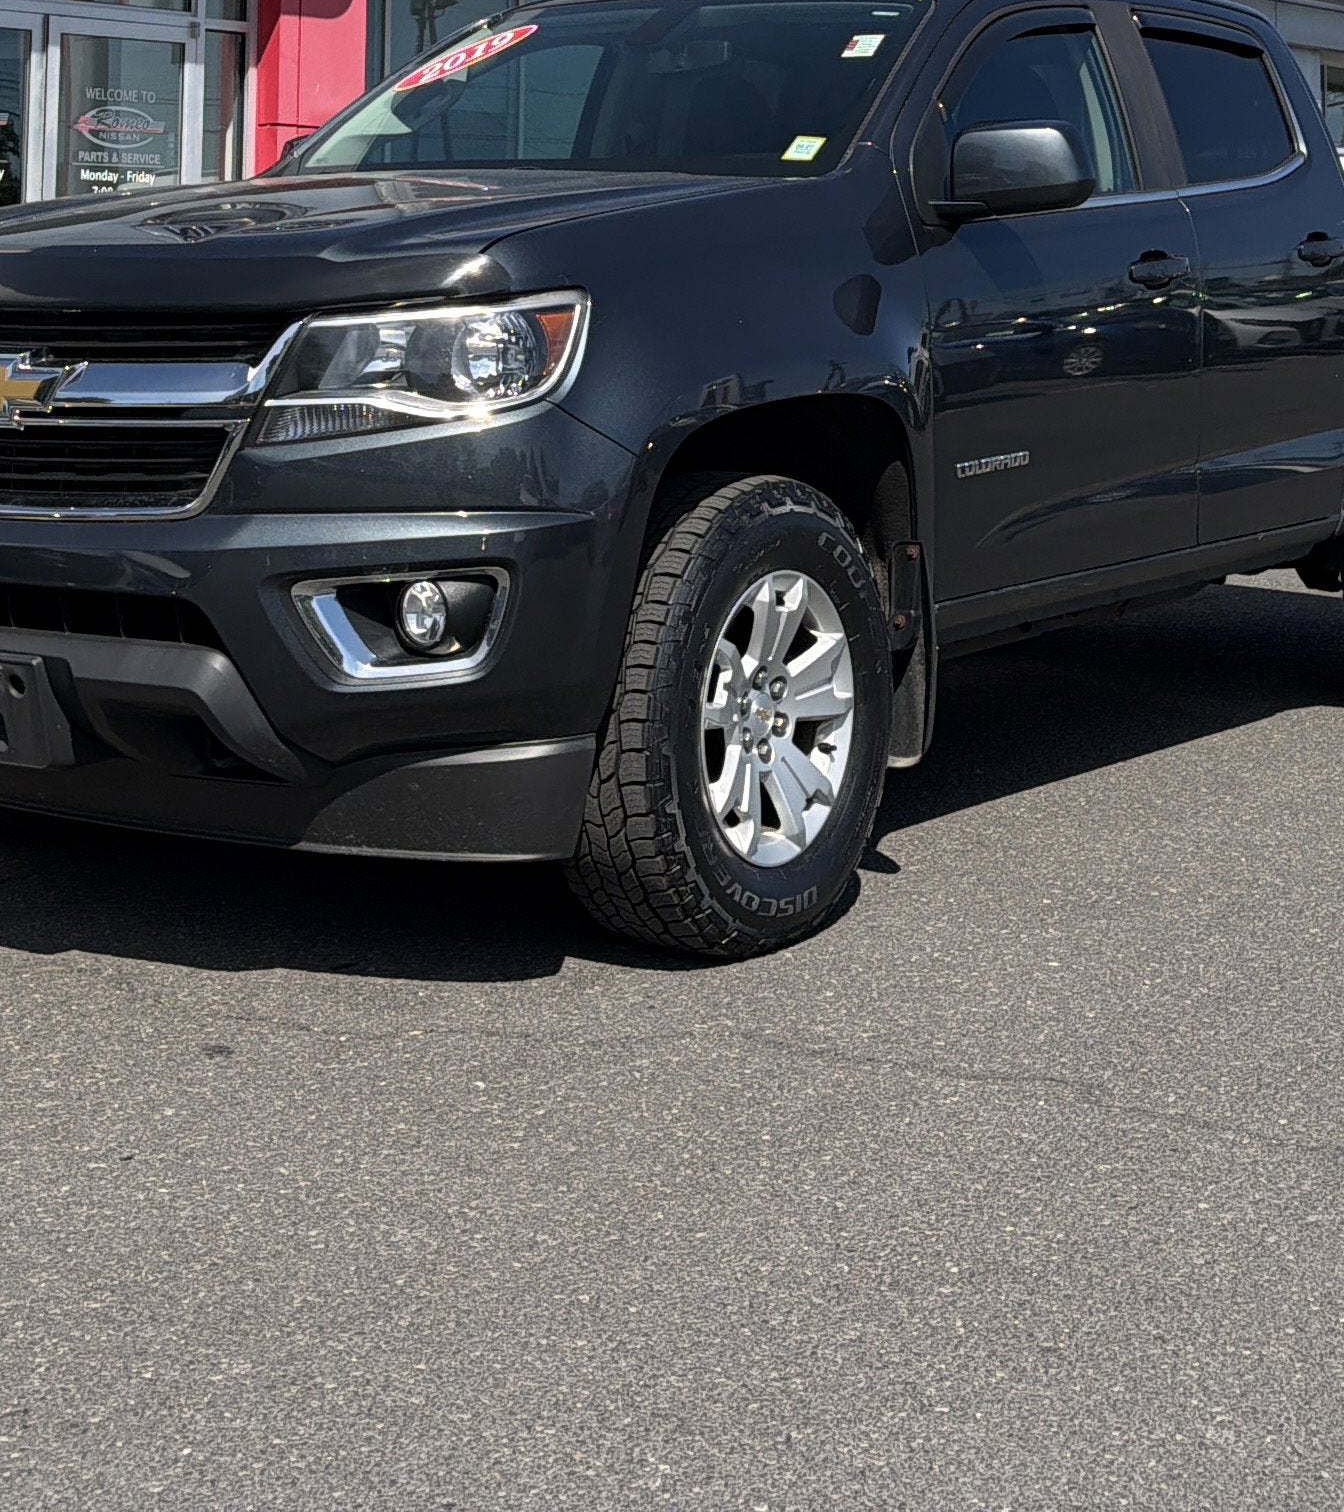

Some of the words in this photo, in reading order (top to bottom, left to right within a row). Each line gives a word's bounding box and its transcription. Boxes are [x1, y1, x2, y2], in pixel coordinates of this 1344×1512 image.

[420, 31, 515, 84] 2019
[85, 88, 139, 102] WELCOME
[141, 91, 156, 103] TO
[92, 109, 151, 132] Romeo
[98, 131, 141, 142] NISSAN
[78, 150, 109, 163] PARTS
[111, 152, 119, 163] &
[121, 154, 161, 165] SERVICE
[80, 168, 119, 183] Monday
[126, 171, 155, 186] Friday
[955, 451, 1030, 479] COLORADO
